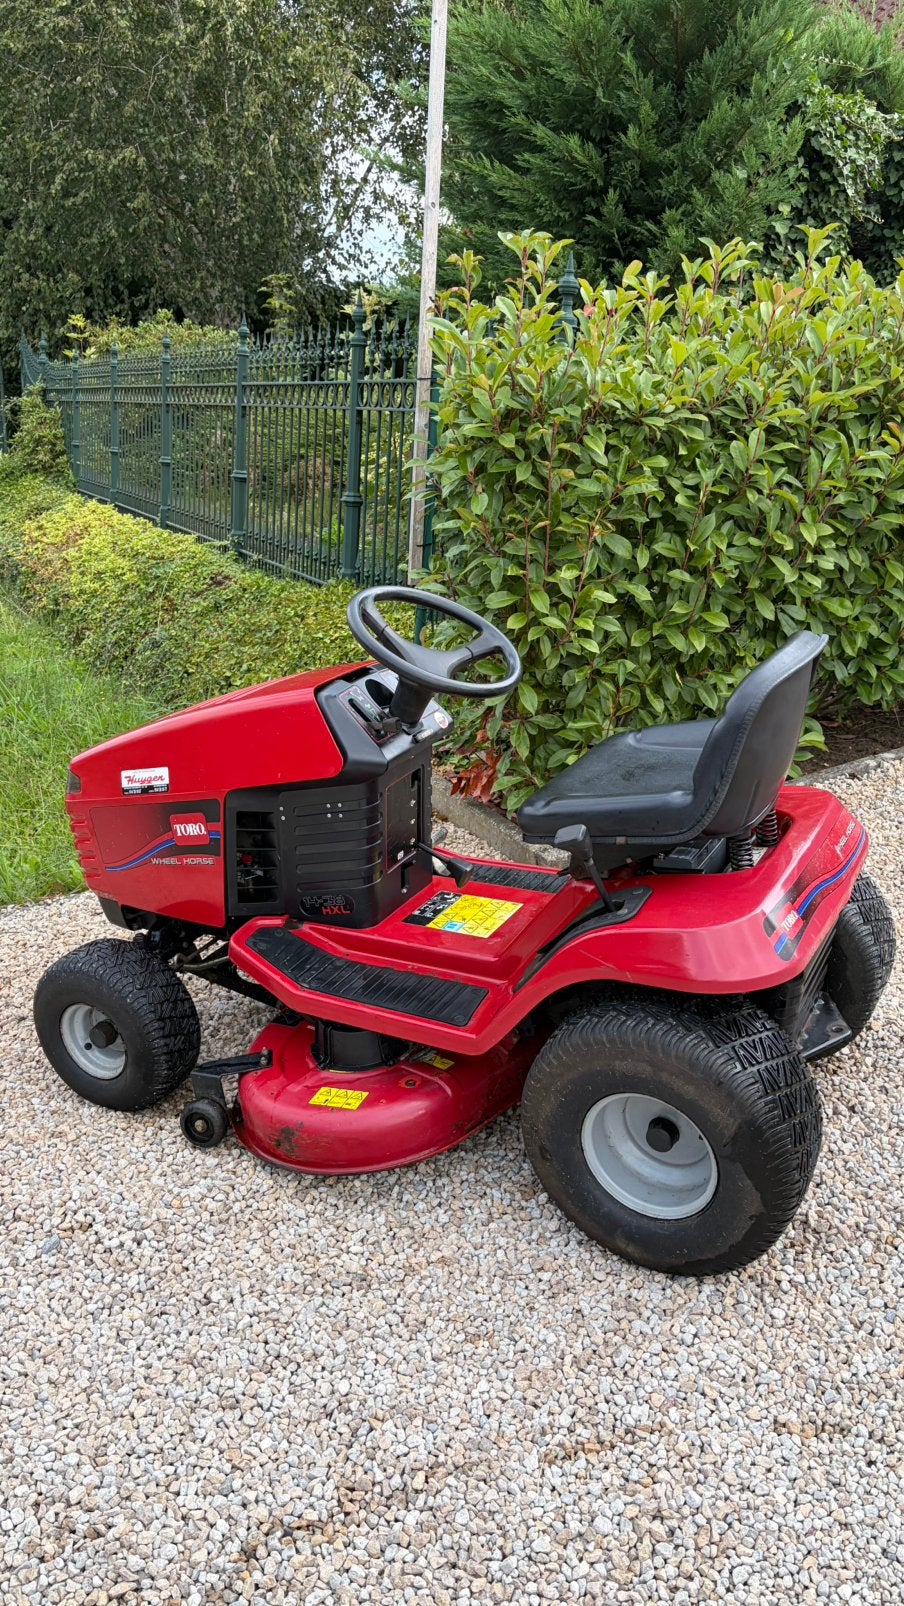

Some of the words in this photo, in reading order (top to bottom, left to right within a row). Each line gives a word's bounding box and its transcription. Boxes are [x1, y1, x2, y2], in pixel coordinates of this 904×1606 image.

[124, 774, 165, 785] Huygen
[173, 823, 206, 836] TORO
[151, 857, 181, 865] WHEEL
[183, 857, 215, 865] HORSE
[321, 905, 352, 916] HXL
